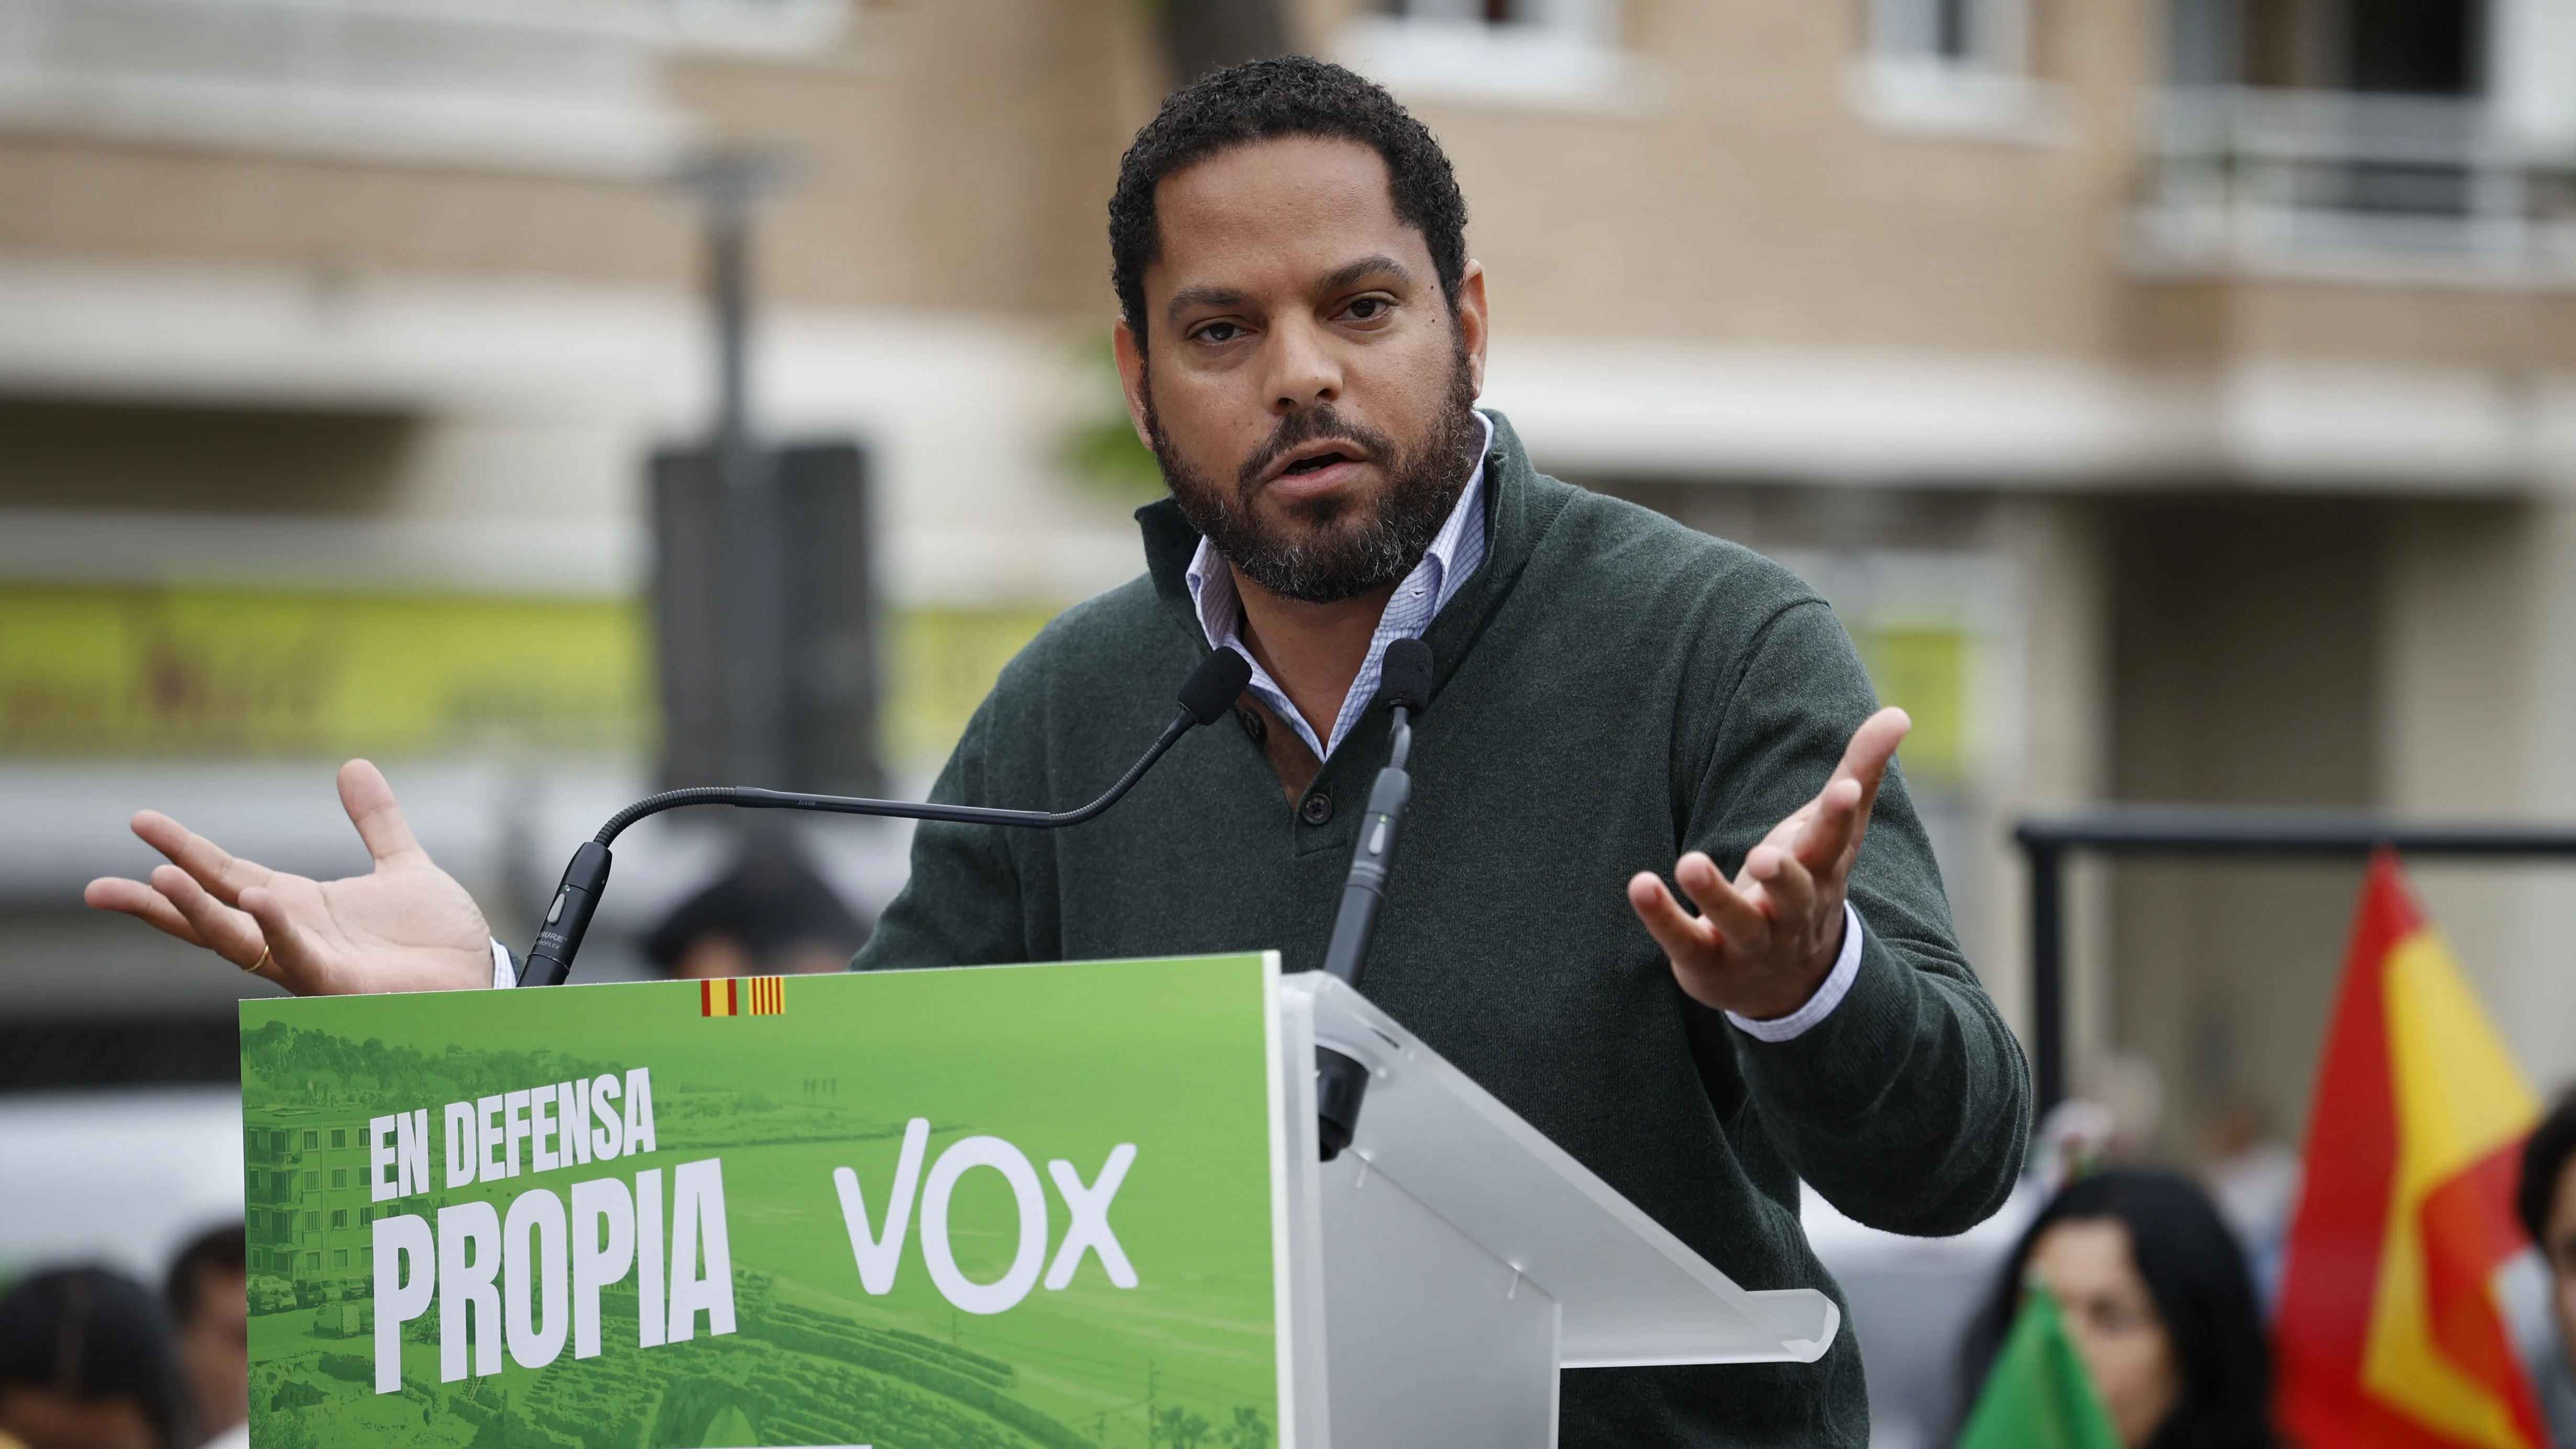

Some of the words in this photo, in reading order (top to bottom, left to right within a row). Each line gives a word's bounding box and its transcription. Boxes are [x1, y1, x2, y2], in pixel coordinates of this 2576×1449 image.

[539, 931, 564, 942] HURE
[370, 1109, 430, 1202] EN
[445, 1067, 657, 1189] DEFENSA
[833, 1117, 1139, 1315] VOX
[373, 1157, 737, 1395] PROPIA
